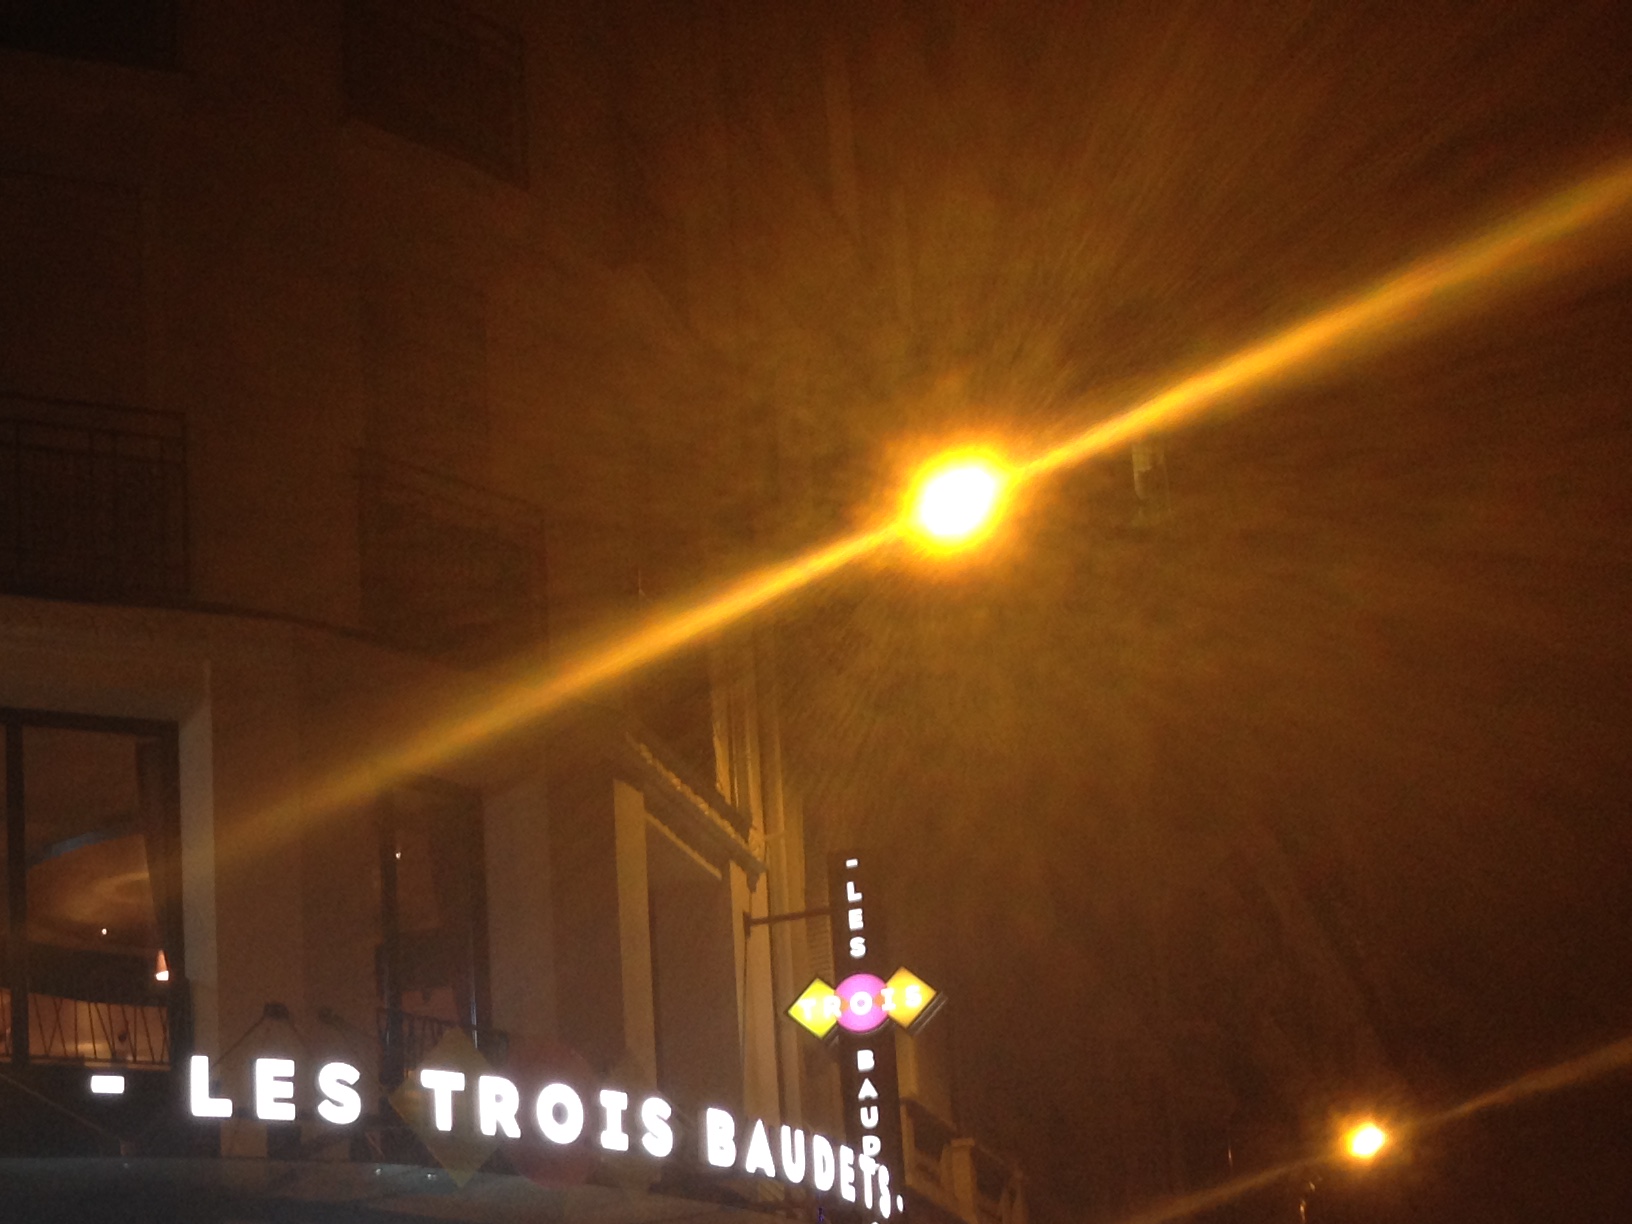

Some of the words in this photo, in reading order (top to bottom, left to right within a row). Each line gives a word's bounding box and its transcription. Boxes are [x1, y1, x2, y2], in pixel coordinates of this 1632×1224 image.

[846, 881, 866, 958] LES
[798, 983, 923, 1021] TROIS
[189, 1054, 362, 1125] LES
[419, 1068, 674, 1158] TROIS
[703, 1106, 892, 1220] BAUDETS
